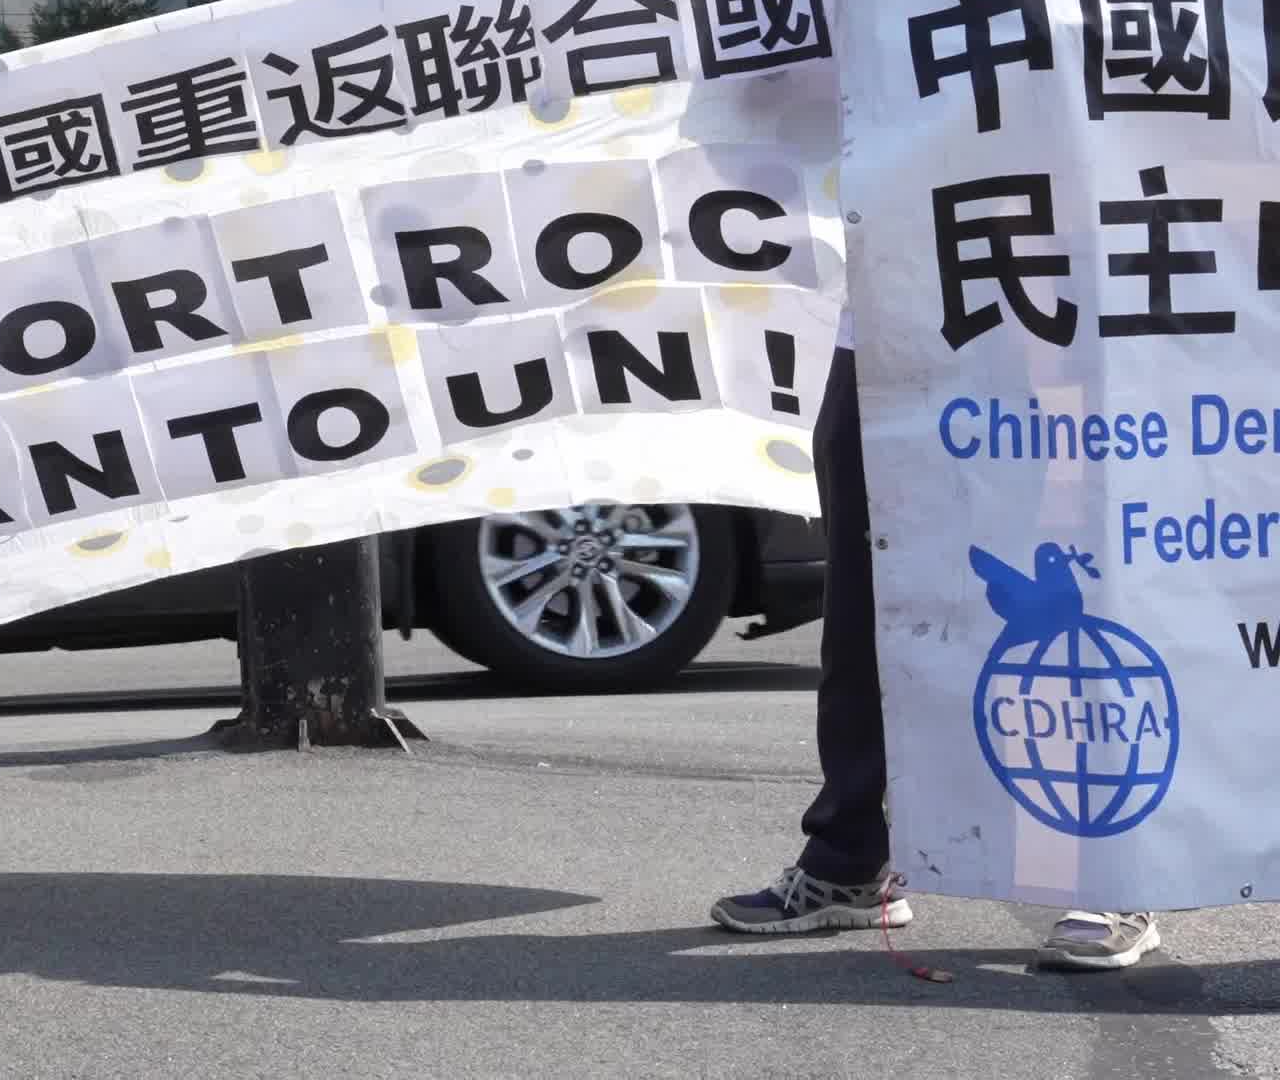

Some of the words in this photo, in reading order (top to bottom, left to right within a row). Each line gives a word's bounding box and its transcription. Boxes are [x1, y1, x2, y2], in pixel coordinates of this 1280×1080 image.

[395, 189, 792, 311] ROC
[932, 166, 1280, 351] 民主
[167, 387, 390, 483] TO
[939, 397, 1168, 460] Chinese
[1192, 394, 1280, 456] De
[1122, 499, 1280, 565] Feder
[991, 696, 1162, 744] CDHRA
